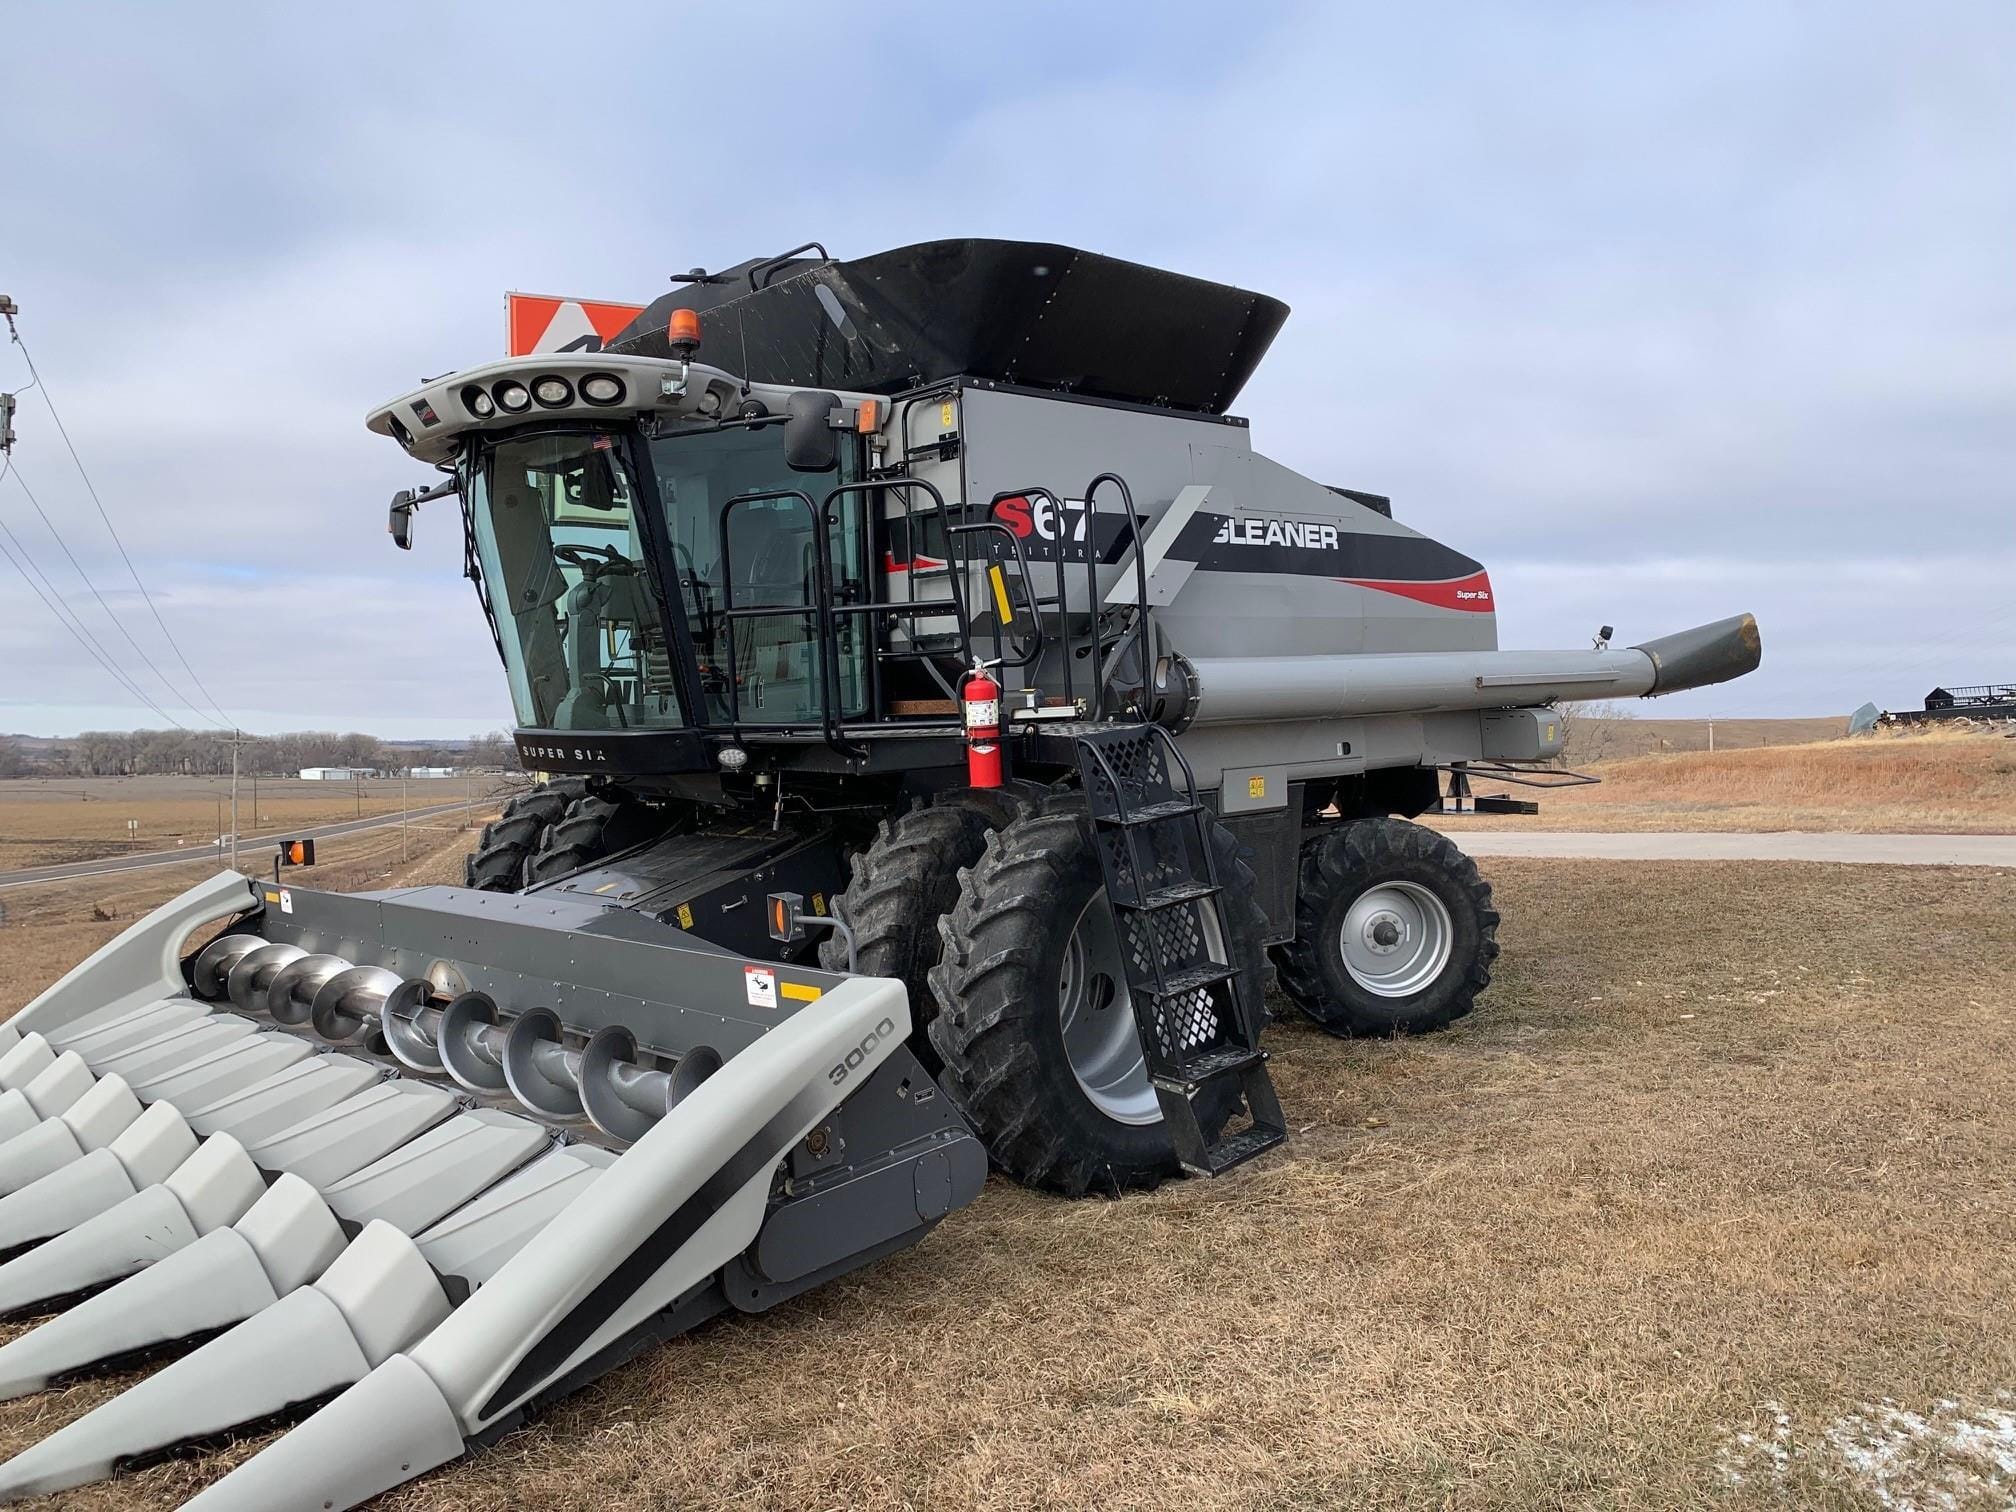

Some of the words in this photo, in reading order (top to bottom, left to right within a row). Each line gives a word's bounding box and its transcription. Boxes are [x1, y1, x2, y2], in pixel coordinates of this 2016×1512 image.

[994, 494, 1096, 542] S67
[1456, 590, 1477, 600] Super
[1477, 591, 1489, 600] Six
[522, 745, 565, 759] SUPER
[828, 1017, 895, 1086] 3000
